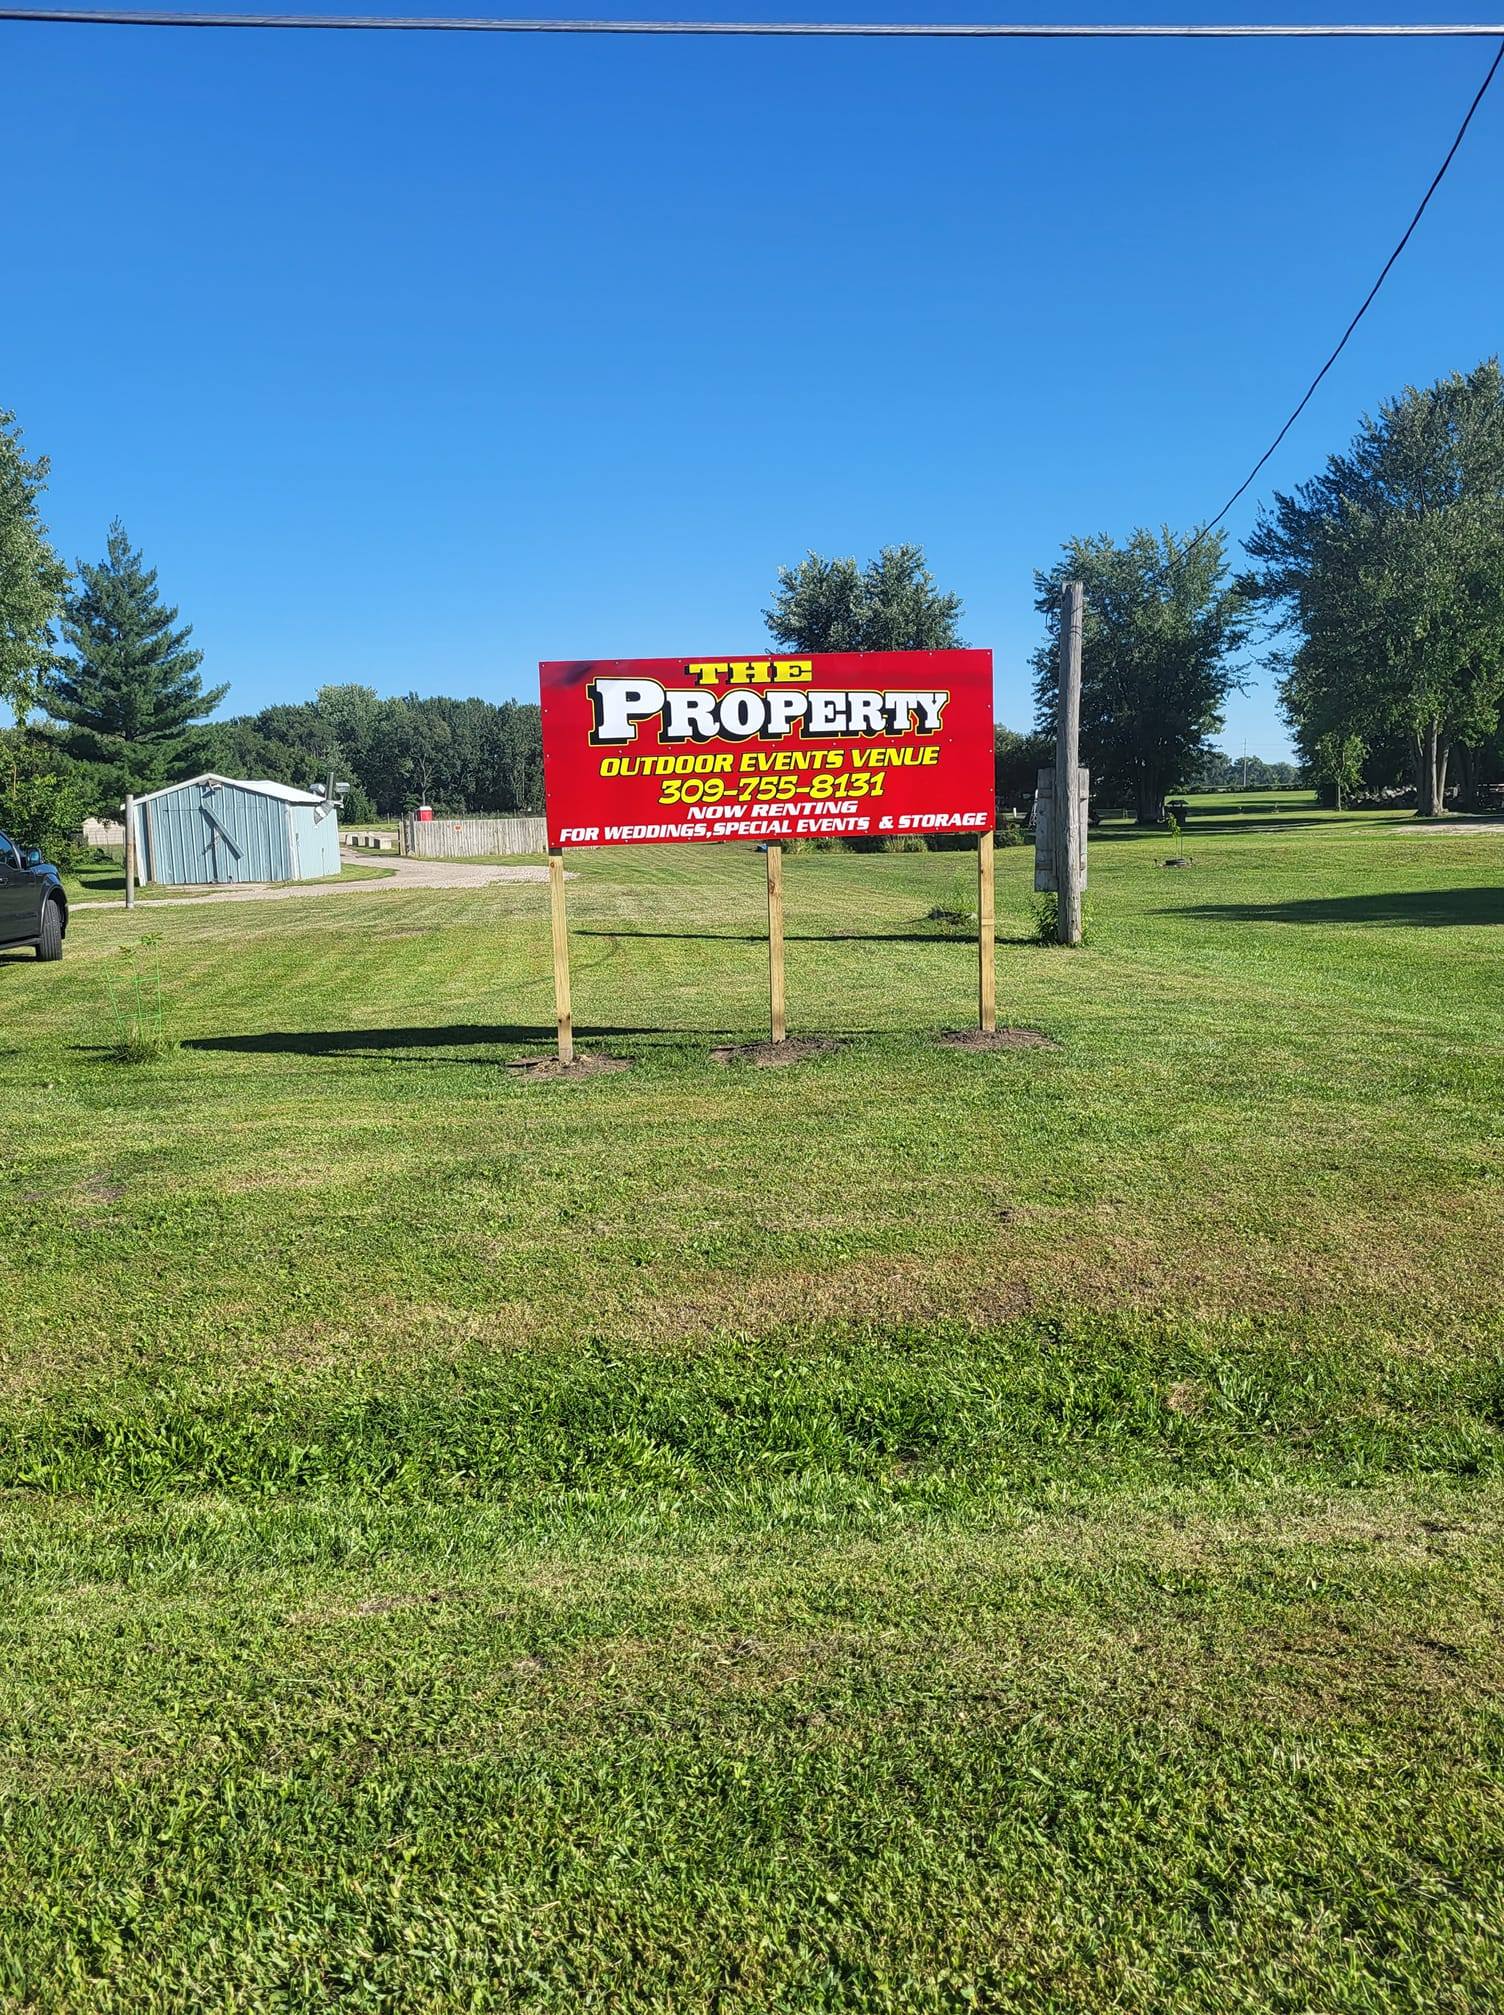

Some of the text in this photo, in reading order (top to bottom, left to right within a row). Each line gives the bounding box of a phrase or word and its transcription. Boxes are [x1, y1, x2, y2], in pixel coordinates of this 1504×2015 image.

[686, 661, 812, 685] THE
[590, 678, 949, 743] PROPERTY
[599, 746, 940, 777] OUTDOOR EVENTS VENUE
[658, 771, 886, 805] 309-755-8131
[687, 801, 859, 820] NOW RENTING
[559, 827, 600, 842] FOR
[796, 816, 871, 833] EVENTS
[878, 816, 894, 830] &
[898, 812, 988, 829] STORAGE
